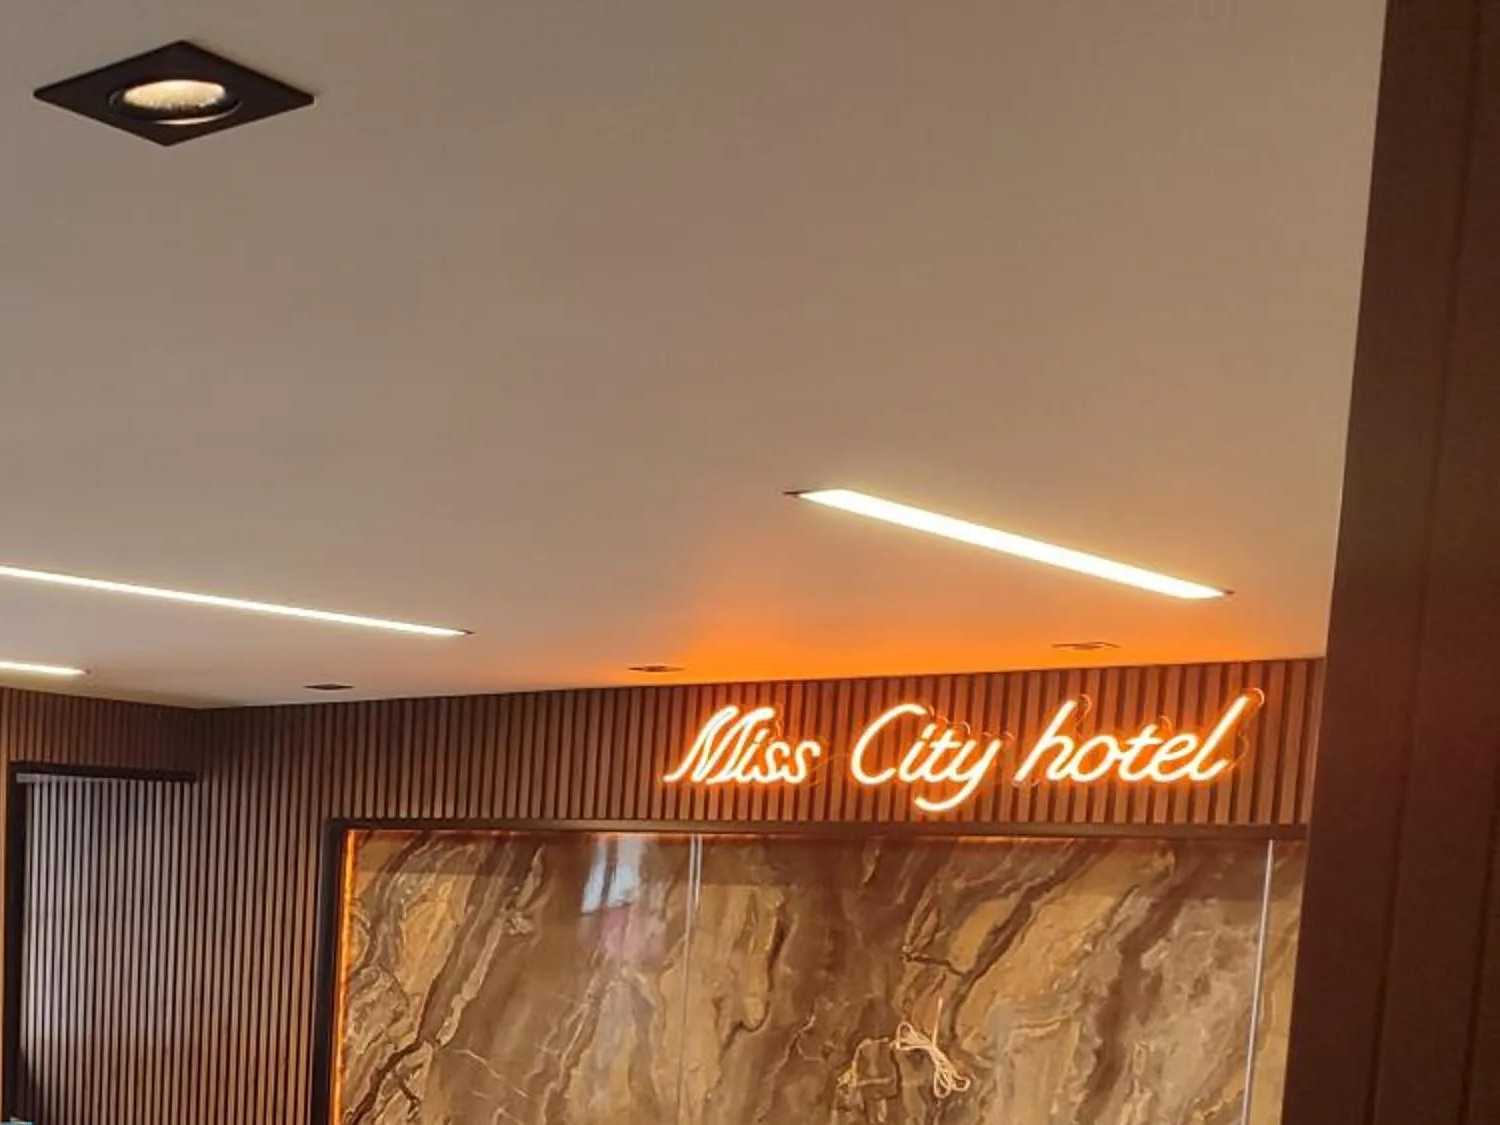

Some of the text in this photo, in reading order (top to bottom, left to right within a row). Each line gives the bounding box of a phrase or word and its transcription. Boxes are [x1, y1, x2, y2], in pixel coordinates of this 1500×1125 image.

[662, 688, 1258, 812] Miss City hotel
